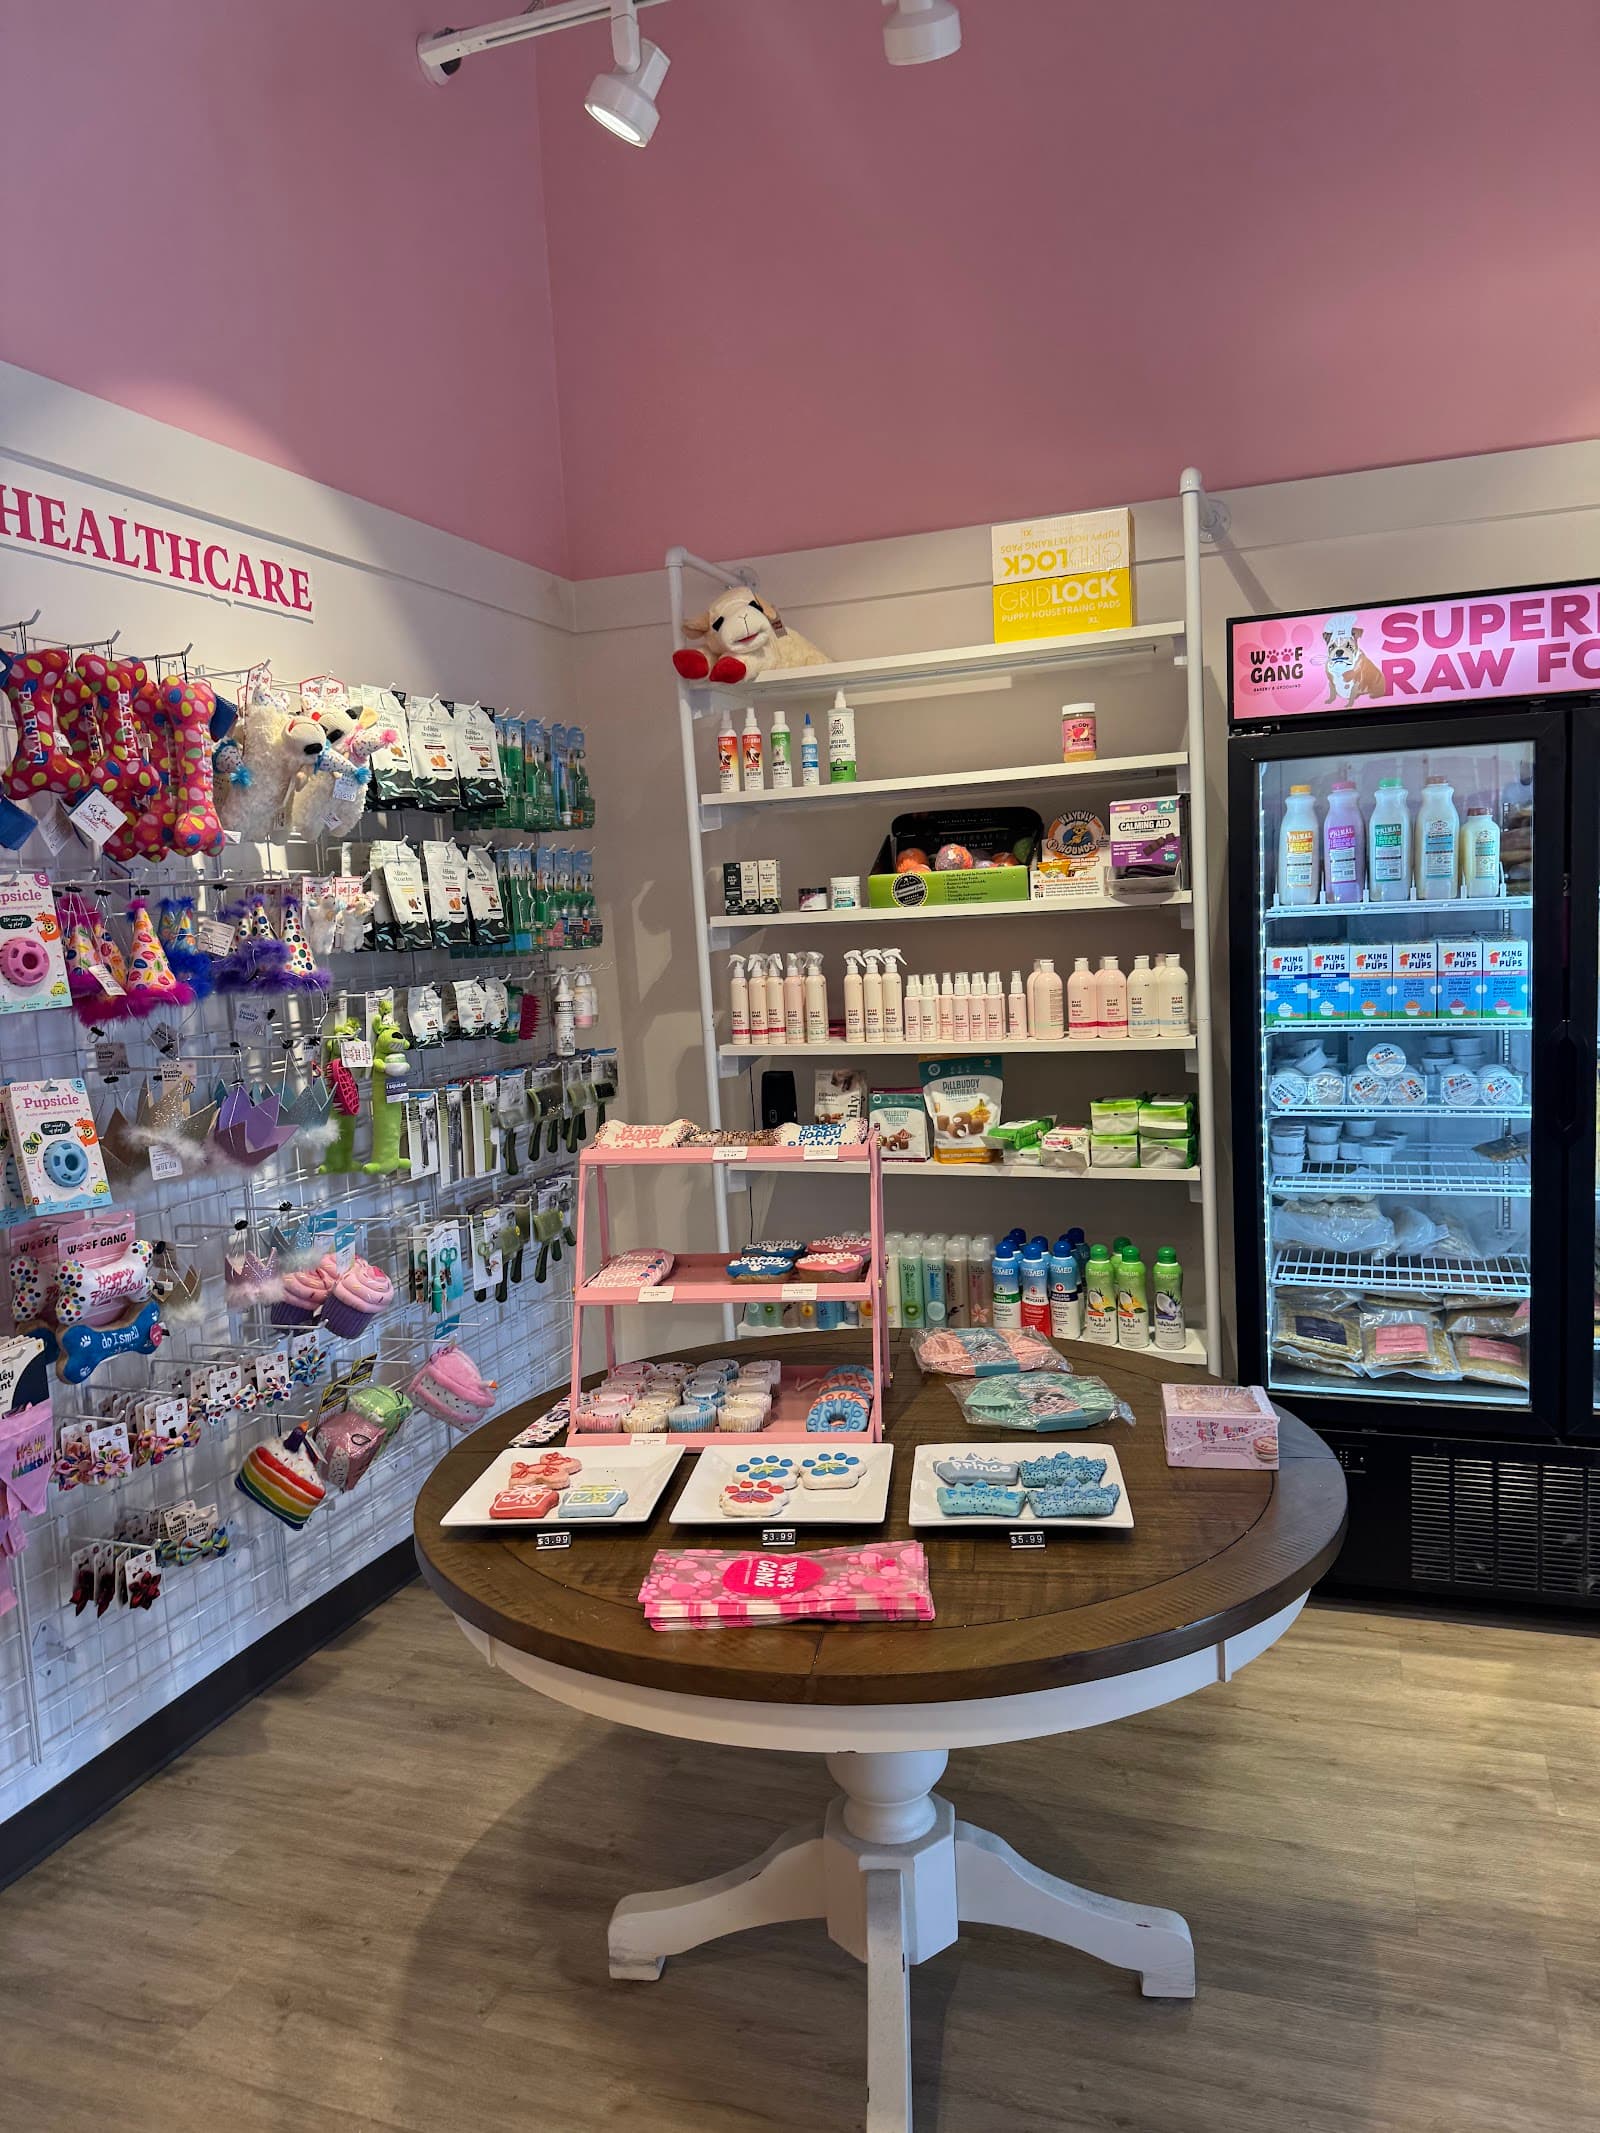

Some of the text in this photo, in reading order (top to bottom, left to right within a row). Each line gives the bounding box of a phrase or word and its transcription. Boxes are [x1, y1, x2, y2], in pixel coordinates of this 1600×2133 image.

[0, 484, 313, 612] HEALTHCARE
[1000, 575, 1119, 612] GRIDLOCK
[1002, 611, 1031, 623] PUPPY
[1098, 600, 1121, 609] PADS
[1381, 592, 1600, 655] SUPER
[1250, 663, 1304, 684] GANG
[1384, 647, 1515, 697] RAW
[18, 688, 45, 765] PARTY!
[118, 691, 141, 762] PARTY!
[1058, 809, 1096, 826] HEAVENLY
[1120, 819, 1171, 831] CALMING AID
[1058, 841, 1097, 857] HOUNDS
[39, 873, 47, 883] S
[0, 890, 42, 906] psicle
[1366, 962, 1388, 970] PUPS
[1409, 961, 1432, 969] PUPS
[76, 1080, 83, 1089] S
[23, 1095, 79, 1110] Pupsicle
[846, 1094, 861, 1124] hly
[798, 1128, 842, 1141] Happy
[100, 1232, 128, 1248] GANG
[95, 1268, 135, 1289] Happy
[90, 1279, 146, 1305] Birthday
[101, 1327, 140, 1350] do I smell
[0, 1380, 12, 1391] nt
[537, 1534, 569, 1546] $3.99
[762, 1532, 794, 1542] $3.99
[1010, 1534, 1044, 1545] $5.99
[753, 1559, 779, 1588] GANG
